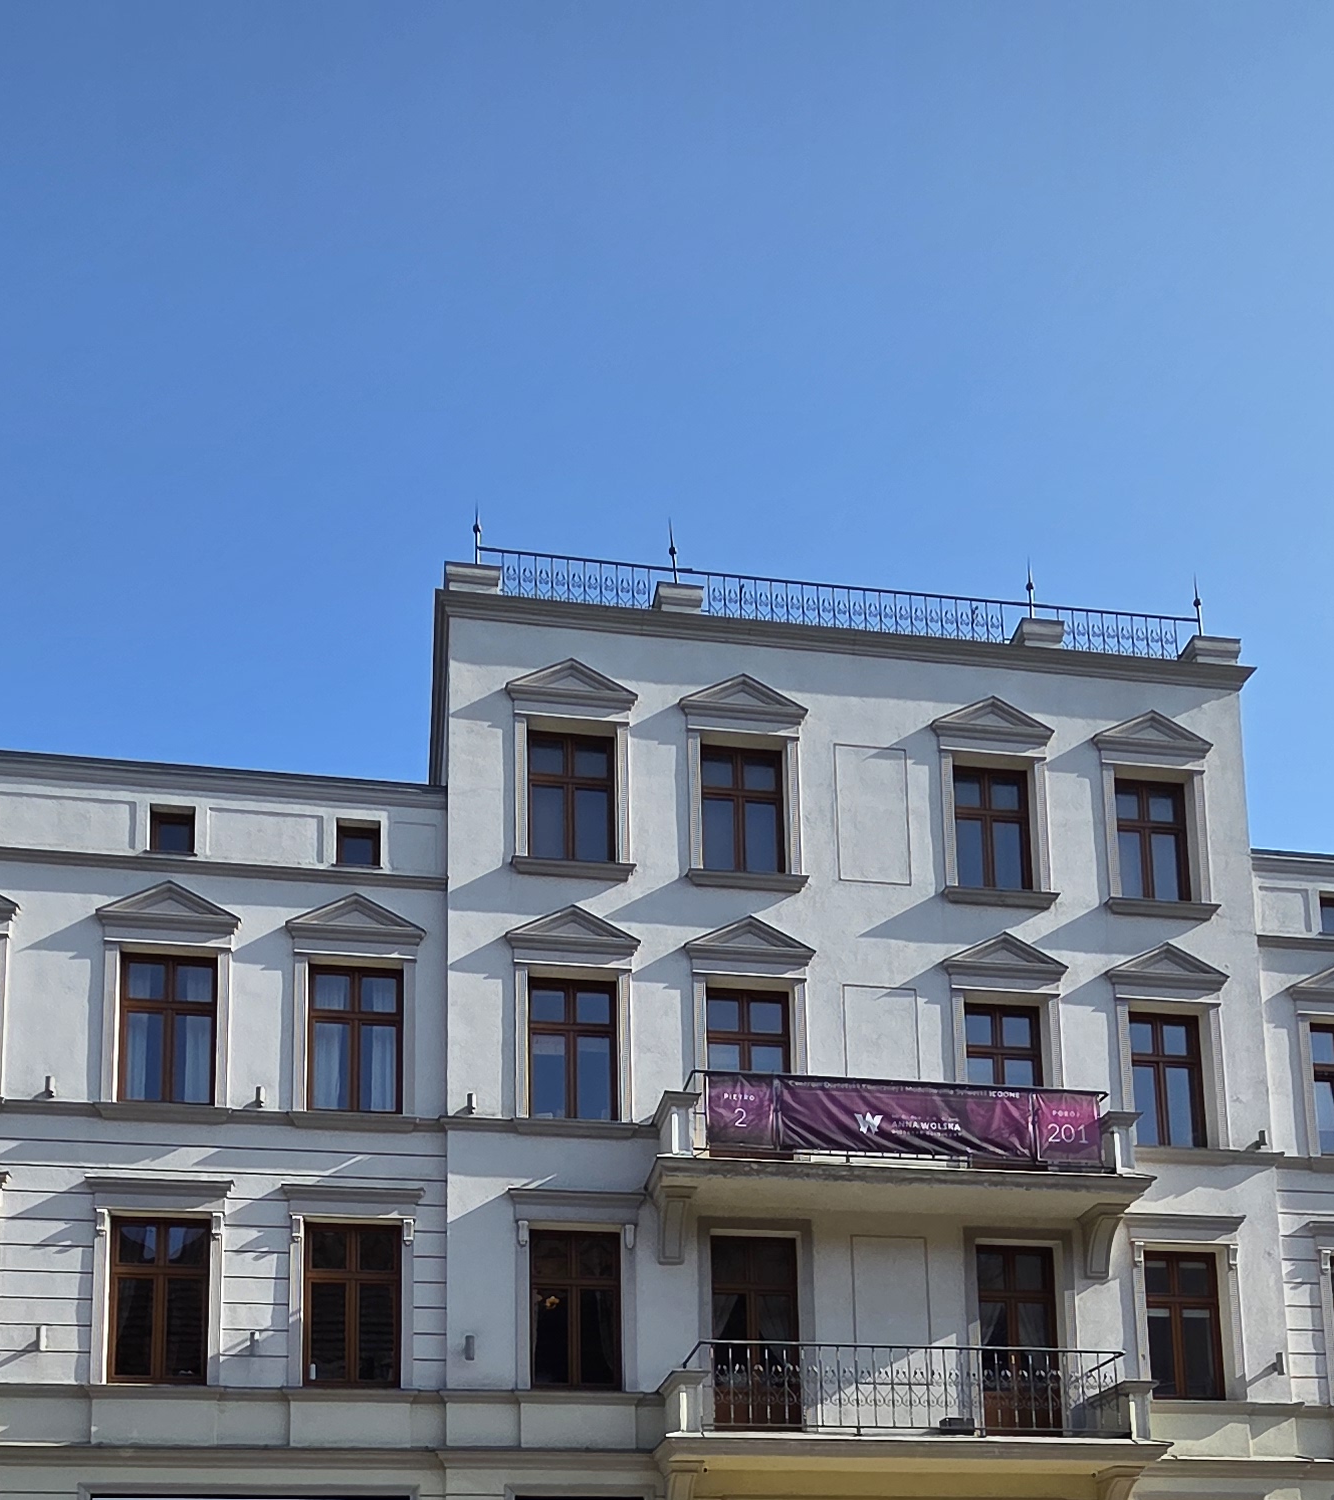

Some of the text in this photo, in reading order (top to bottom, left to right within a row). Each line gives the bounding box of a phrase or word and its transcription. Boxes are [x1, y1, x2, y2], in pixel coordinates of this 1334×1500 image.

[734, 1107, 747, 1127] 2
[891, 1120, 962, 1132] ANNA WOLSKA
[1048, 1123, 1089, 1144] 201
